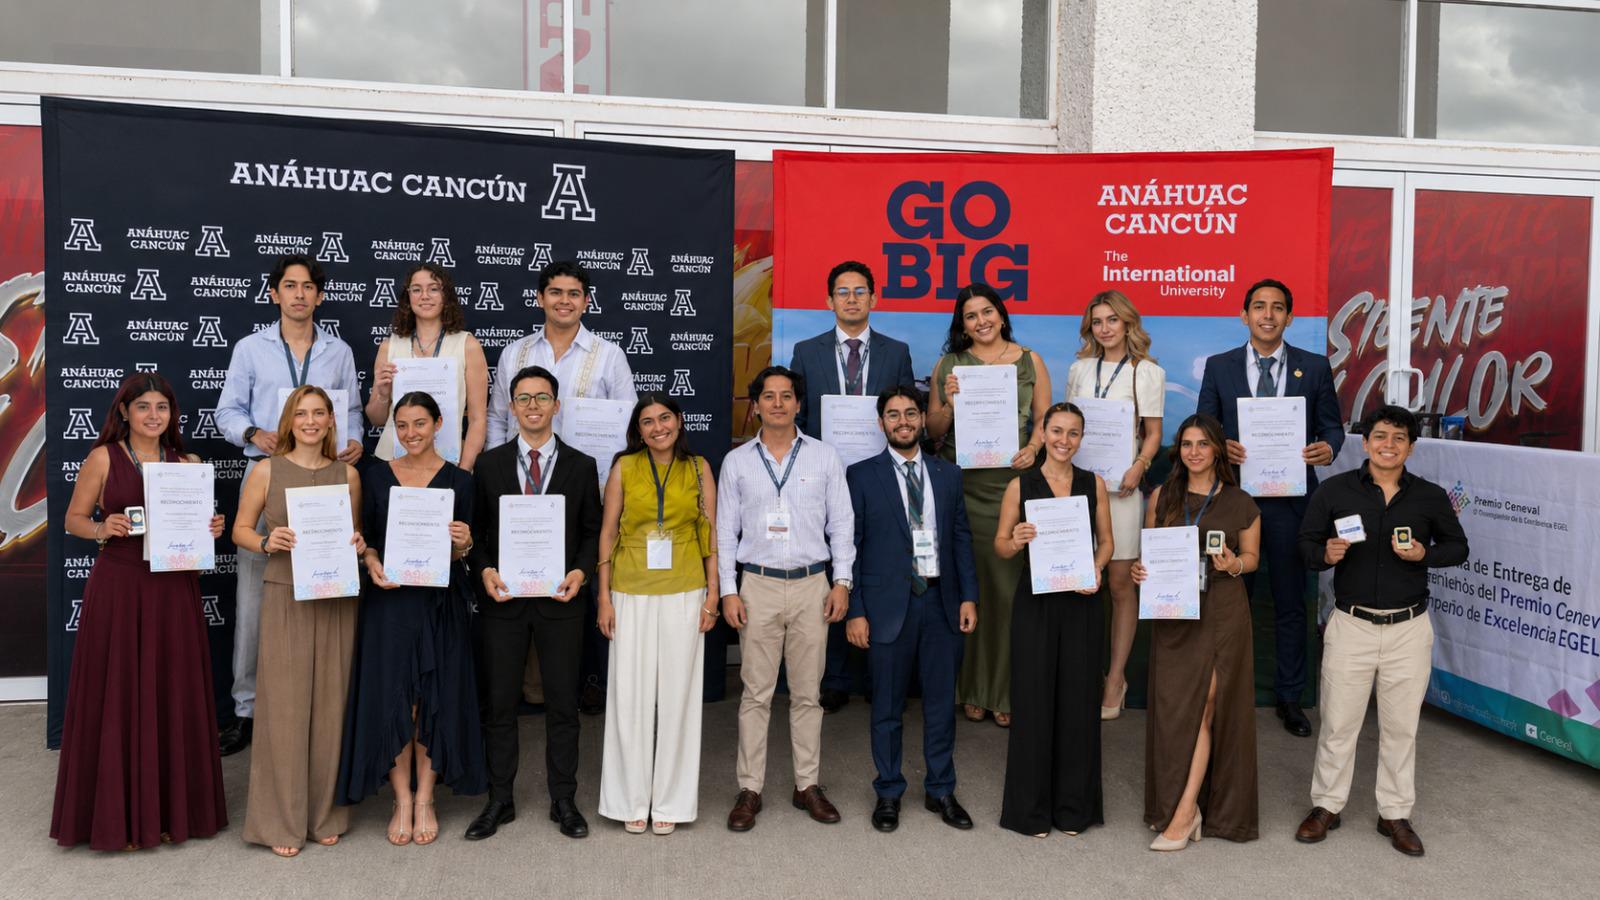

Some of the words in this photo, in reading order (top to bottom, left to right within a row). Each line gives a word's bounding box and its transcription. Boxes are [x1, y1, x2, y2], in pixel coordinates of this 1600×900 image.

[230, 158, 392, 194] ANÁHUAC
[402, 174, 527, 203] CANCÚN
[1097, 178, 1248, 206] ANÁHUAC
[886, 180, 1011, 241] GO
[1105, 207, 1238, 234] CANCÚN
[126, 226, 190, 240] ANÁHUAC
[254, 232, 313, 246] ANÁHUAC
[130, 238, 186, 251] CANCÚN
[258, 242, 309, 256] CANCÚN
[371, 238, 424, 252] ANÁHUAC
[475, 244, 526, 257] ANÁHUAC
[374, 248, 422, 262] CANCÚN
[477, 254, 522, 266] CANCÚN
[576, 249, 624, 260] ANÁHUAC
[670, 253, 714, 264] ANÁHUAC
[1104, 250, 1128, 262] The
[579, 260, 621, 270] CANCÚN
[672, 263, 711, 274] CANCÚN
[881, 242, 1029, 302] BIG
[62, 269, 126, 284] ANÁHUAC
[1103, 264, 1236, 282] International
[65, 280, 122, 294] CANCÚN
[190, 274, 252, 289] ANÁHUAC
[324, 279, 366, 292] ÁHUAC
[194, 285, 248, 299] CANCÚN
[322, 290, 363, 302] ANCÚN
[622, 291, 668, 302] ANÁHUAC
[1160, 285, 1226, 299] University
[624, 301, 664, 312] CANCÚN
[126, 318, 190, 332] ANÁHUAC
[474, 326, 524, 338] ANÁHUAC
[130, 328, 185, 342] CANCÚN
[670, 332, 714, 342] ANÁHUAC
[672, 341, 711, 352] CANCÚN
[60, 366, 124, 378] ANÁHUAC
[189, 367, 229, 378] ANÁH
[63, 377, 120, 390] CANCÚN
[192, 380, 225, 390] CANC
[635, 384, 663, 392] NCÚN
[1474, 496, 1502, 509] Premio
[1504, 501, 1540, 516] Ceneval
[1474, 560, 1488, 576] de
[1494, 562, 1548, 592] Entrega
[1554, 576, 1572, 596] de
[1478, 584, 1496, 602] del
[1501, 587, 1552, 616] Premio
[1466, 605, 1480, 622] de
[1484, 608, 1556, 644] Excelencia
[1558, 628, 1600, 657] EGEL
